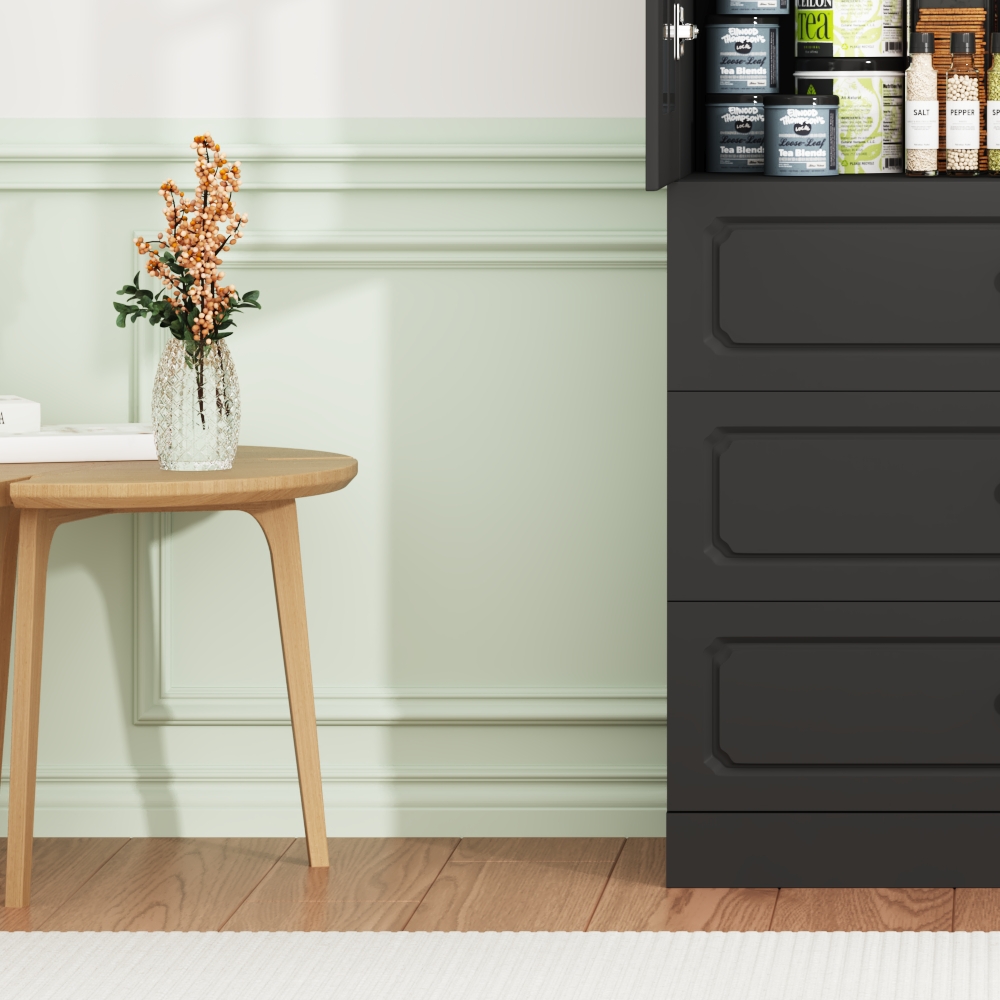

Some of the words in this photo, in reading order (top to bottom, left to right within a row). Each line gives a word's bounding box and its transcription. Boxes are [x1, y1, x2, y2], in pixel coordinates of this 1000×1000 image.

[797, 12, 831, 40] Tea
[719, 56, 767, 67] Loose-Leaf
[719, 66, 735, 75] Tea
[735, 66, 767, 75] Blends
[778, 137, 826, 149] Loose-Leaf
[719, 145, 735, 154] Tea
[778, 148, 794, 157] Tea
[794, 148, 827, 157] Blends
